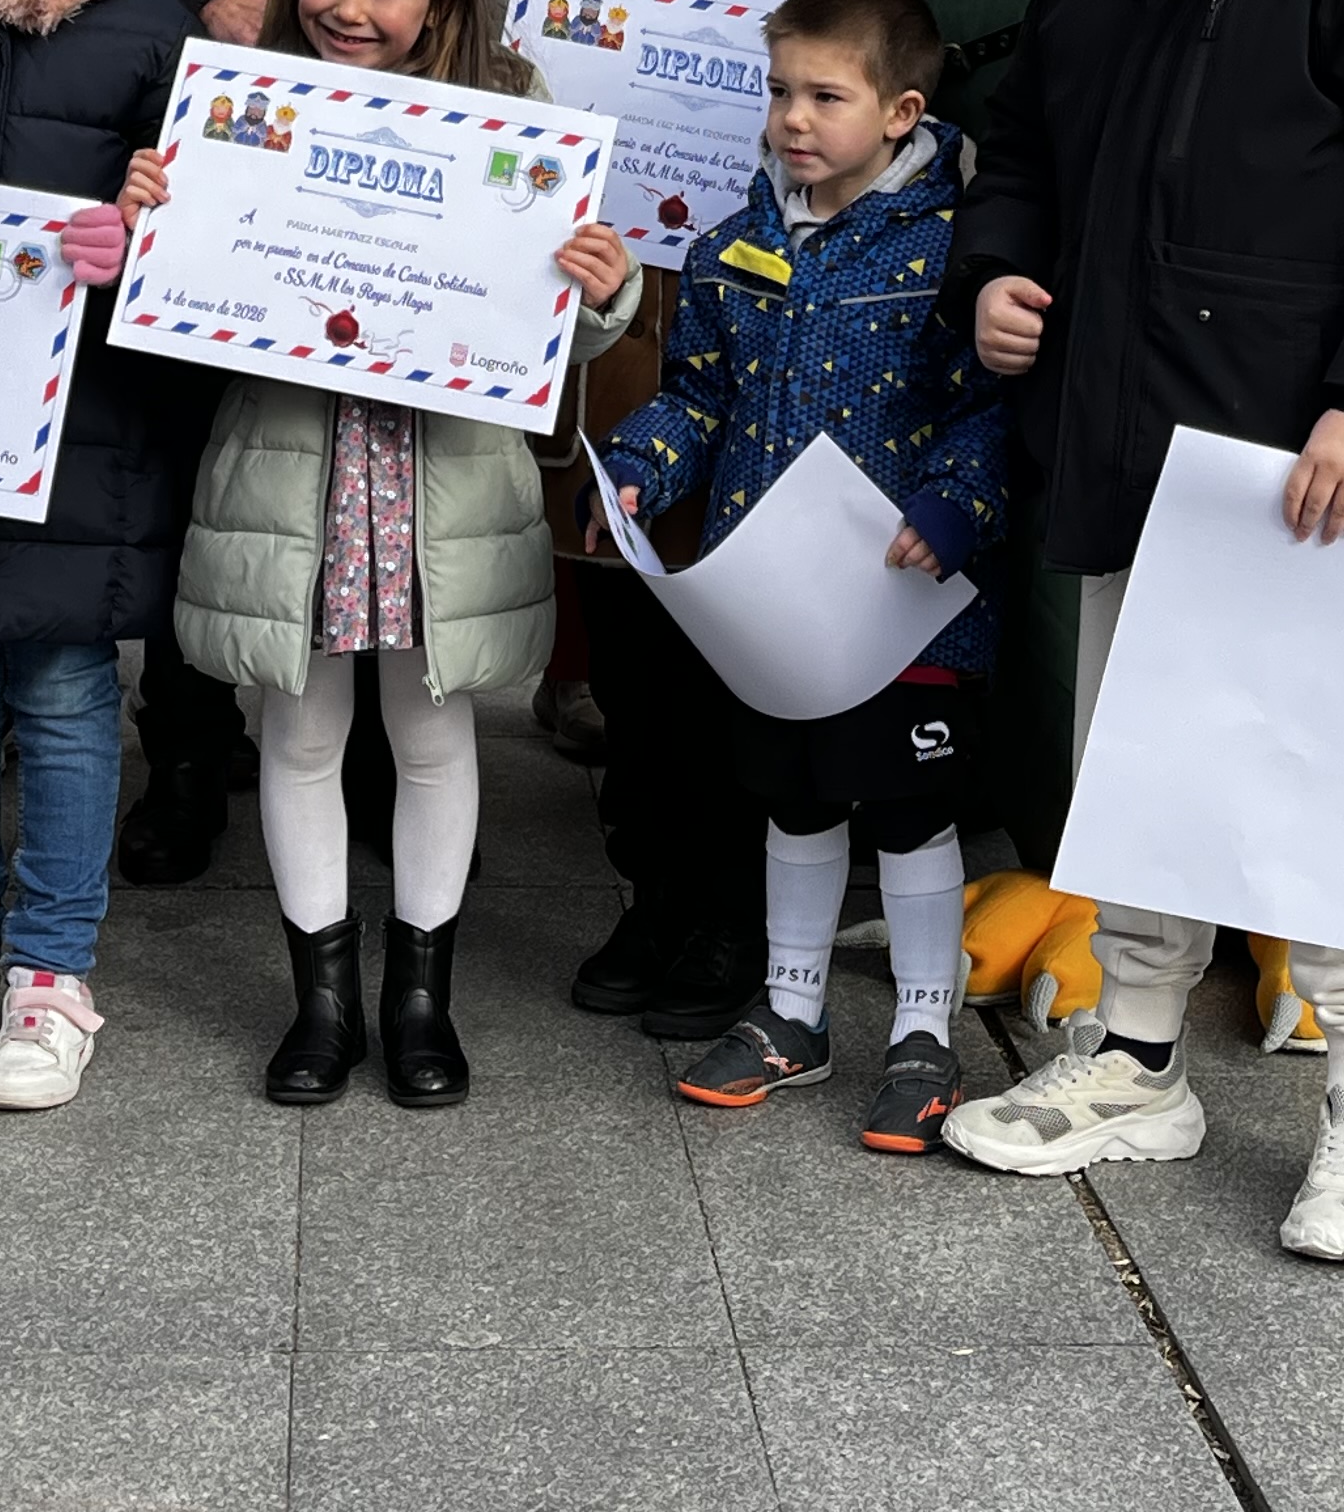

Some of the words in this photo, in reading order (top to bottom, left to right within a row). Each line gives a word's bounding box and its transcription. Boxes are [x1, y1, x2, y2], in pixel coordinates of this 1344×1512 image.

[636, 42, 763, 97] DIPLOMA
[304, 144, 444, 203] DIPLOMA
[653, 141, 666, 155] el
[665, 143, 708, 164] Concurso
[709, 152, 721, 167] de
[723, 155, 753, 173] Cartas
[611, 161, 618, 169] a
[671, 167, 684, 182] los
[686, 170, 717, 192] Reyes
[239, 208, 257, 225] A
[286, 219, 318, 234] PAULA
[375, 236, 418, 254] ESCOLAR
[232, 239, 252, 253] por
[253, 241, 265, 252] su
[264, 245, 302, 260] premio
[307, 253, 319, 263] en
[321, 250, 334, 265] el
[333, 252, 381, 276] Concurso
[382, 262, 396, 278] de
[398, 265, 432, 286] Cartas
[434, 273, 488, 297] Solidarias
[162, 288, 172, 304] 4
[173, 290, 187, 307] de
[188, 299, 215, 313] enero
[216, 299, 230, 316] de
[231, 302, 268, 322] 2026
[274, 272, 281, 280] a
[340, 278, 355, 295] los
[357, 282, 391, 307] Reyes
[392, 290, 433, 315] Magos
[470, 352, 528, 376] Logroño
[769, 965, 821, 986] IPSTA
